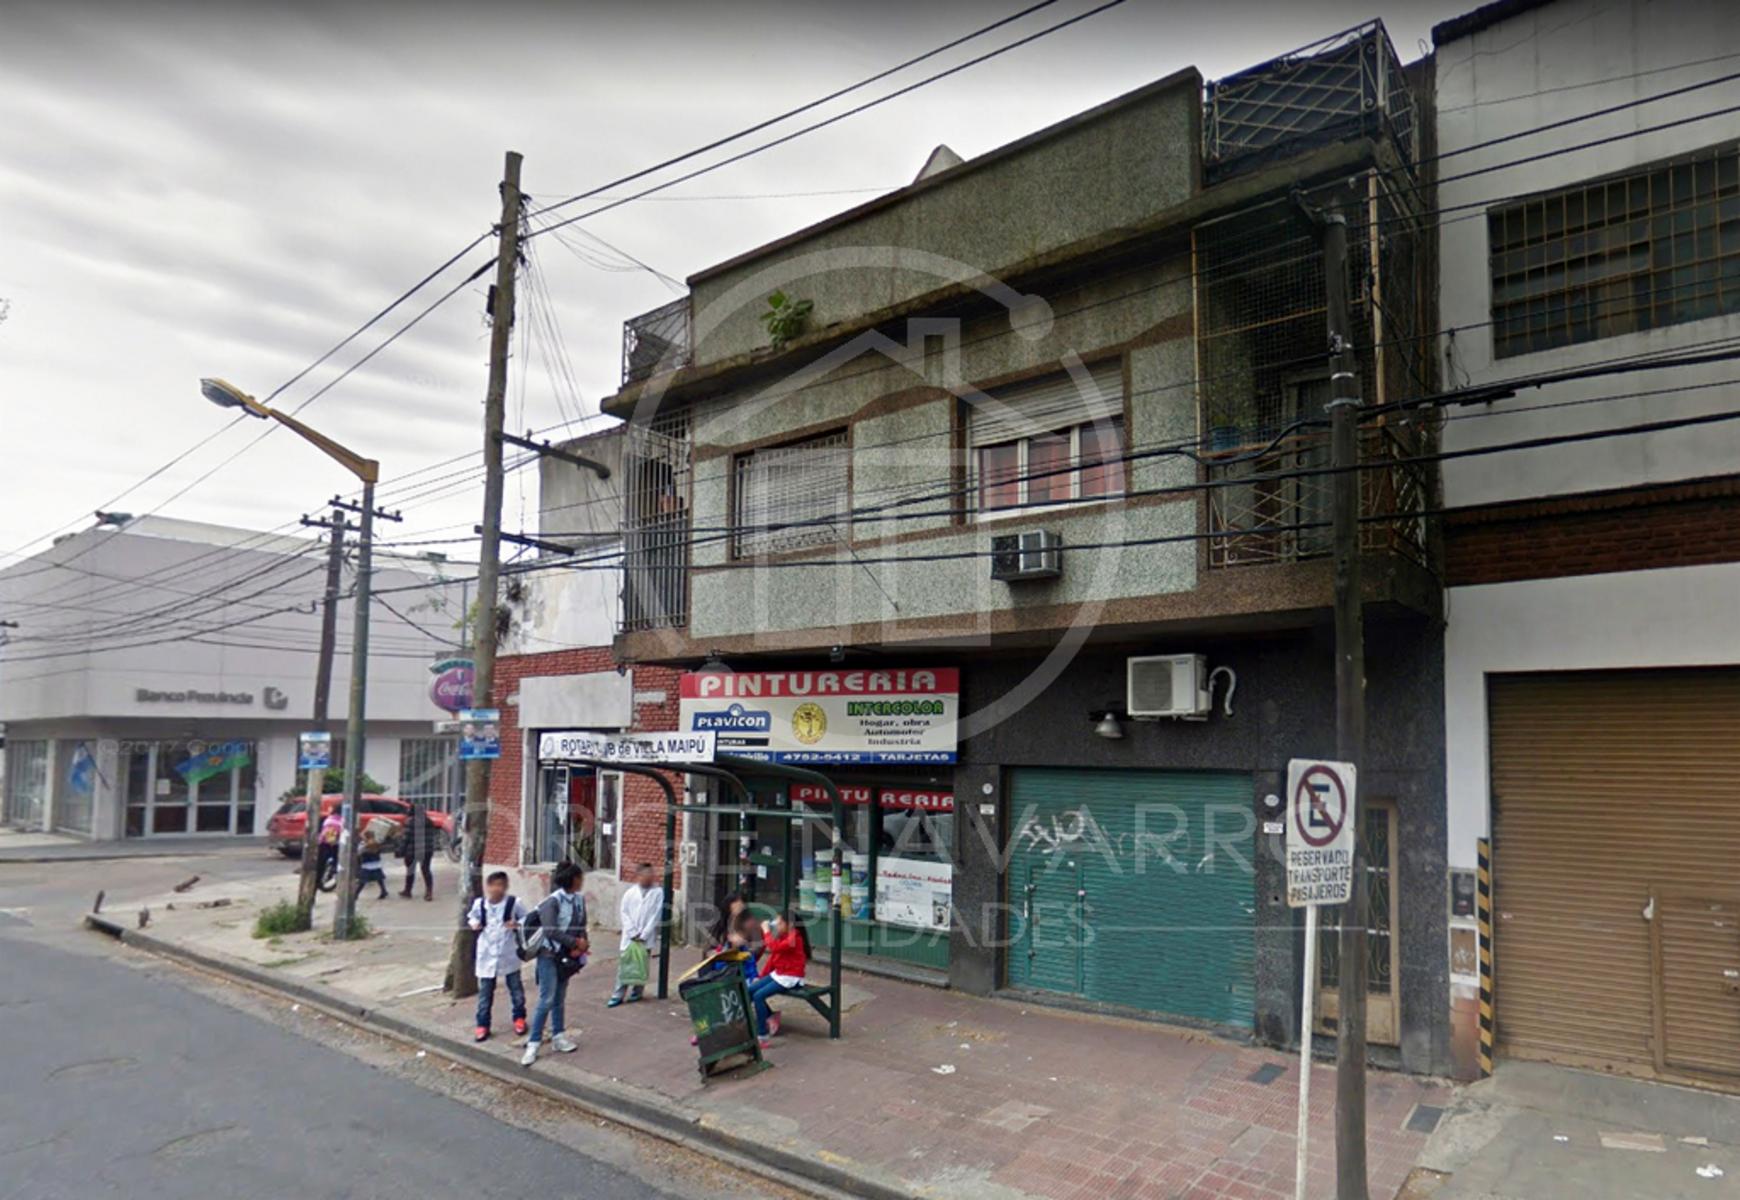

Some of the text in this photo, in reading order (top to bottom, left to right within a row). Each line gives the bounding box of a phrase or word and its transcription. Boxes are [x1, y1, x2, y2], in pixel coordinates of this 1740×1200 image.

[701, 670, 936, 697] PINTURERIA
[847, 700, 944, 716] INTERCOLOR
[667, 734, 706, 754] MAIPÚ
[878, 752, 950, 762] TARJETAS
[1290, 849, 1350, 867] RESERVADO
[1288, 865, 1352, 885] TRANSPORTE
